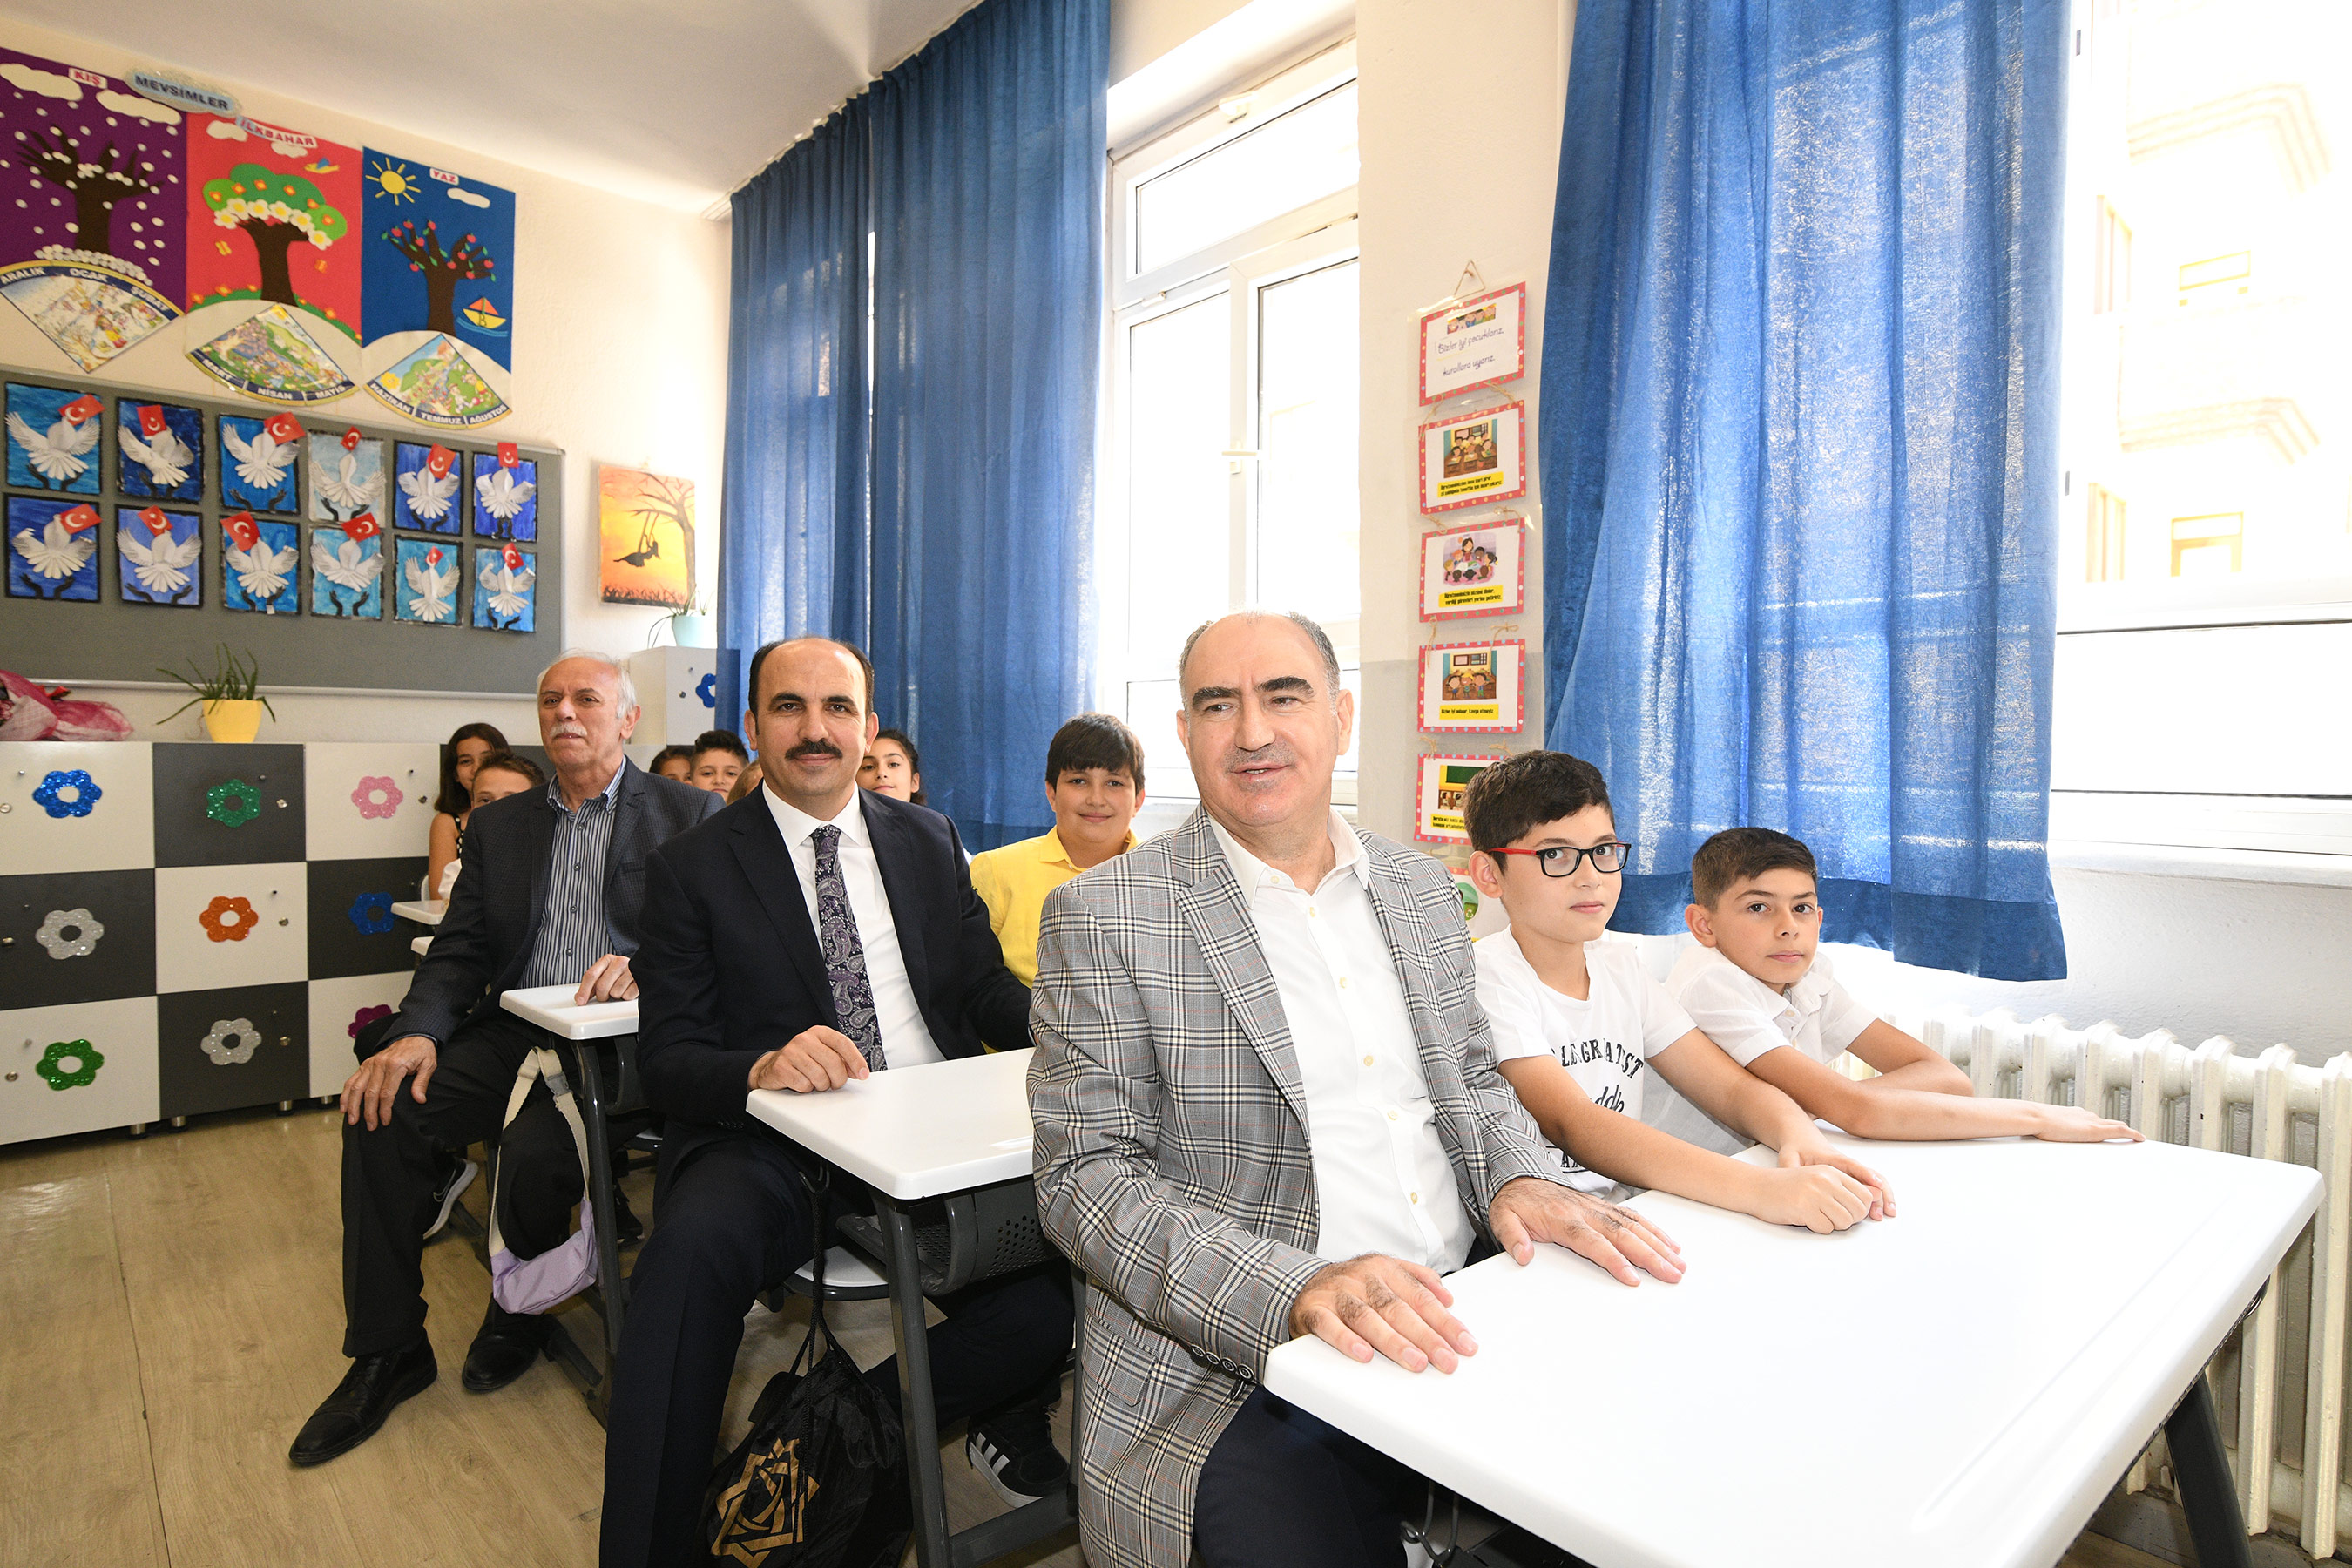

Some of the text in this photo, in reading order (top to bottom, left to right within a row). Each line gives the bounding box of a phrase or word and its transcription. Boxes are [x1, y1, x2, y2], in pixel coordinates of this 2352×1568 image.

[433, 169, 457, 184] YAZ
[0, 267, 46, 285] ARALIK
[69, 268, 108, 283] OCAK
[315, 384, 346, 399] MAYIS
[420, 411, 463, 425] TEMMUZ
